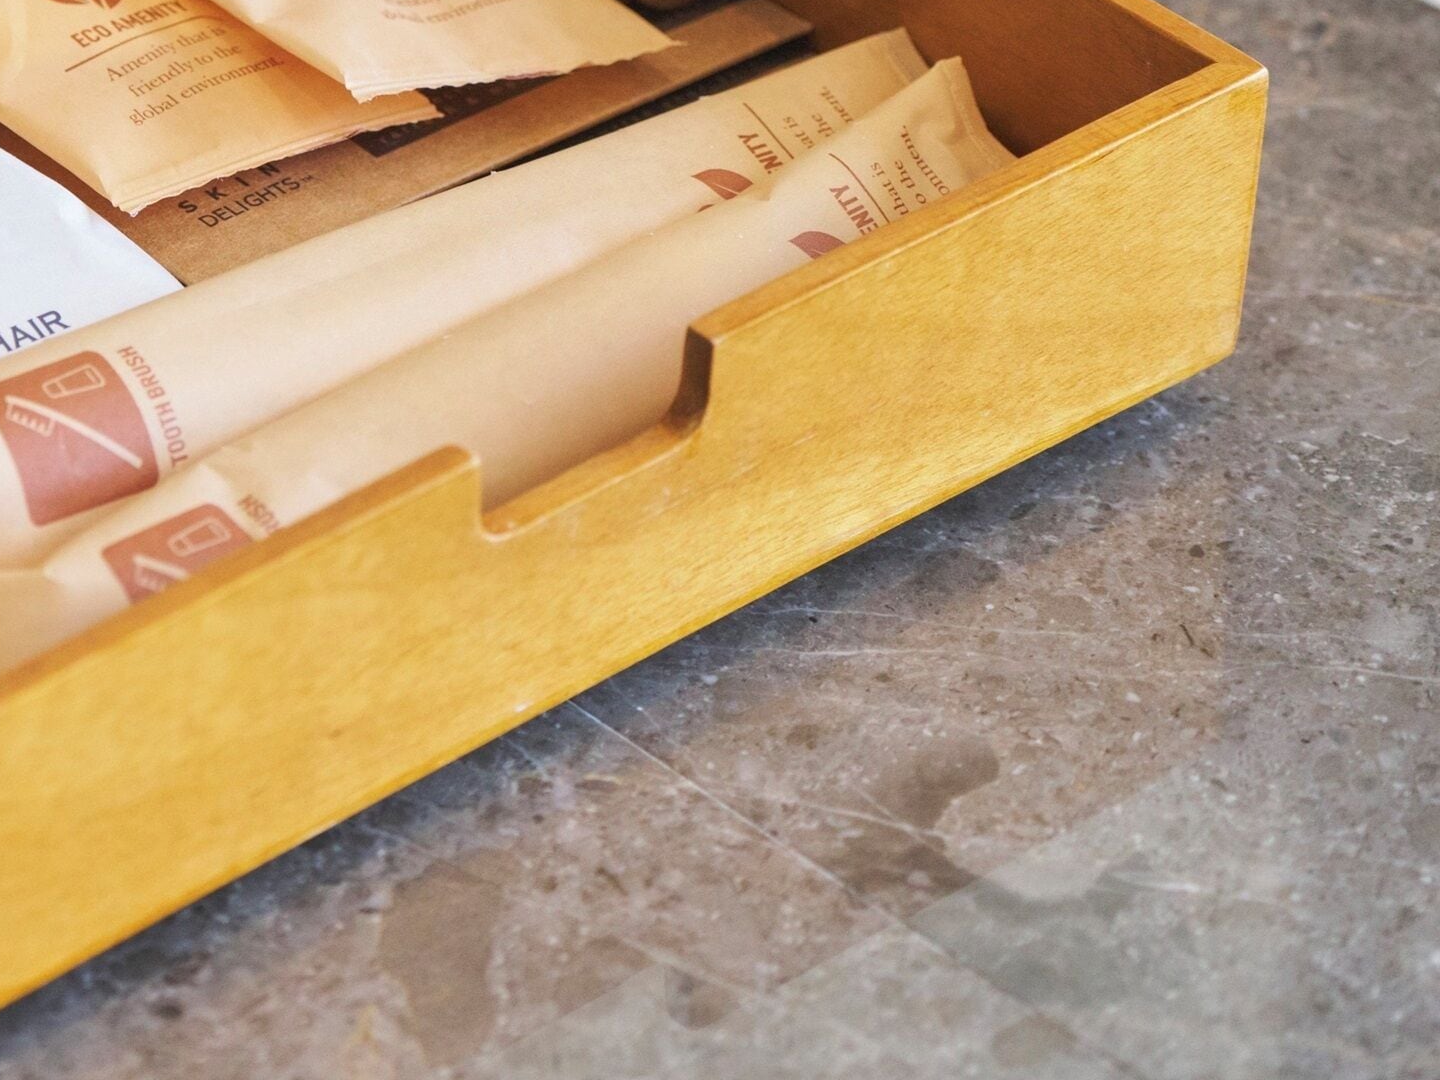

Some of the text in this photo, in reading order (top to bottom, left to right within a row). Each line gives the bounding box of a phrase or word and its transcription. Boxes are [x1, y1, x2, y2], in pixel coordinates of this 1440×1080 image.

[70, 0, 187, 48] ECO AMENITY
[107, 25, 226, 82] Amenity that is
[128, 44, 241, 97] friendly to the
[129, 94, 180, 126] global
[783, 116, 797, 129] is
[738, 133, 783, 174] NITY
[894, 159, 916, 189] the
[829, 185, 879, 236] ENITY
[870, 162, 909, 216] that is
[117, 346, 188, 467] TOOTH BRUSH
